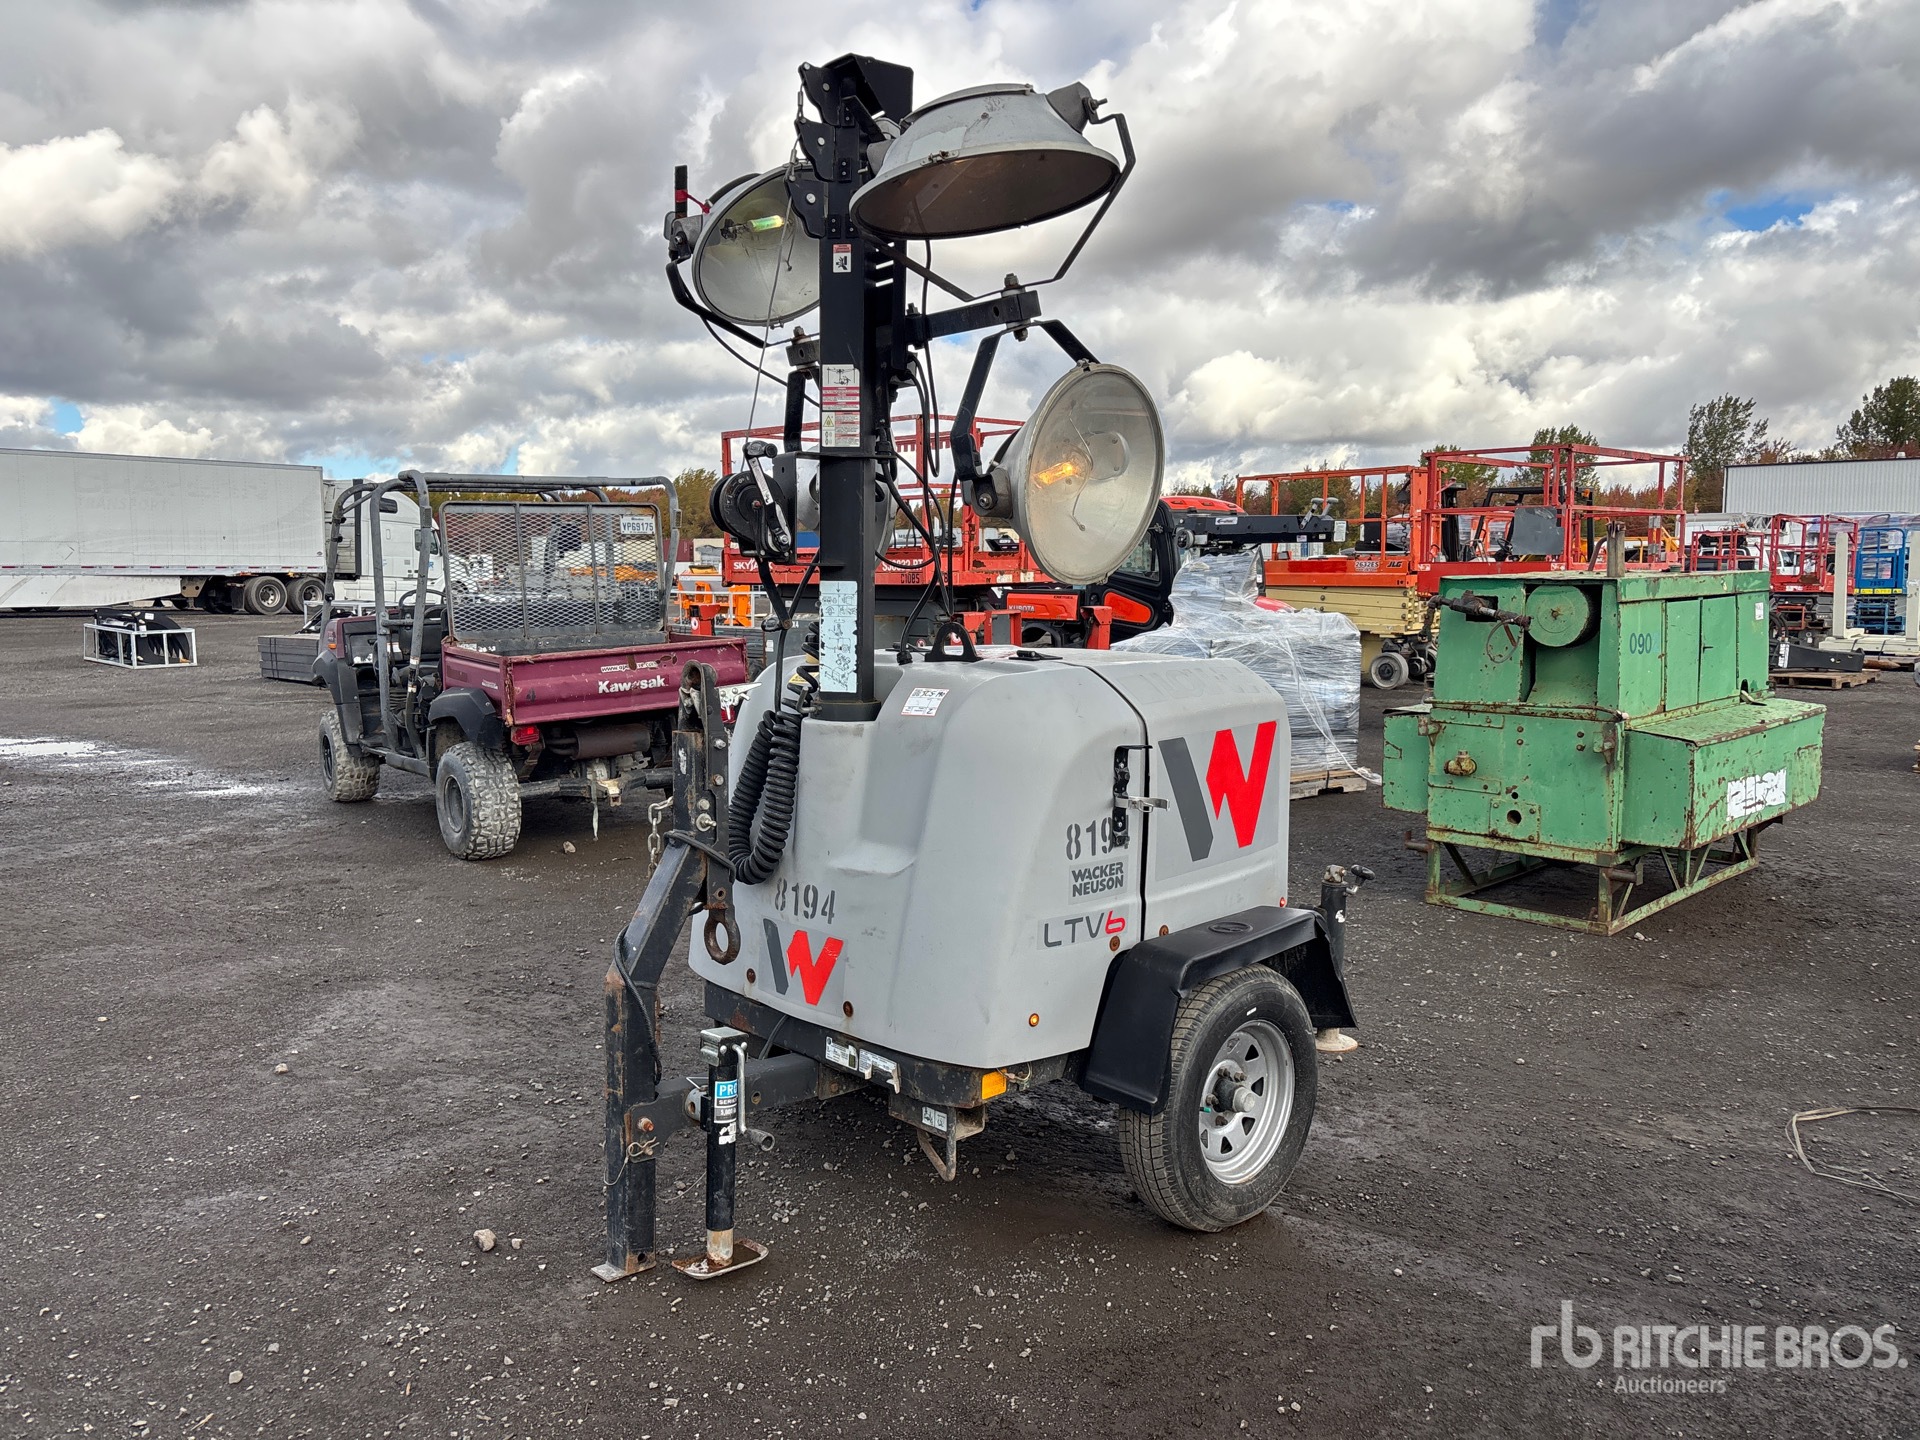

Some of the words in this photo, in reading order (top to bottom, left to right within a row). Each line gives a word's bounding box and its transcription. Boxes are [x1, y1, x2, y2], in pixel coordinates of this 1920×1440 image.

[1066, 816, 1128, 861] 819
[1071, 861, 1124, 883] WACKER
[1072, 874, 1124, 897] NEUSON
[774, 878, 836, 925] 8194
[1044, 910, 1126, 947] LTV6
